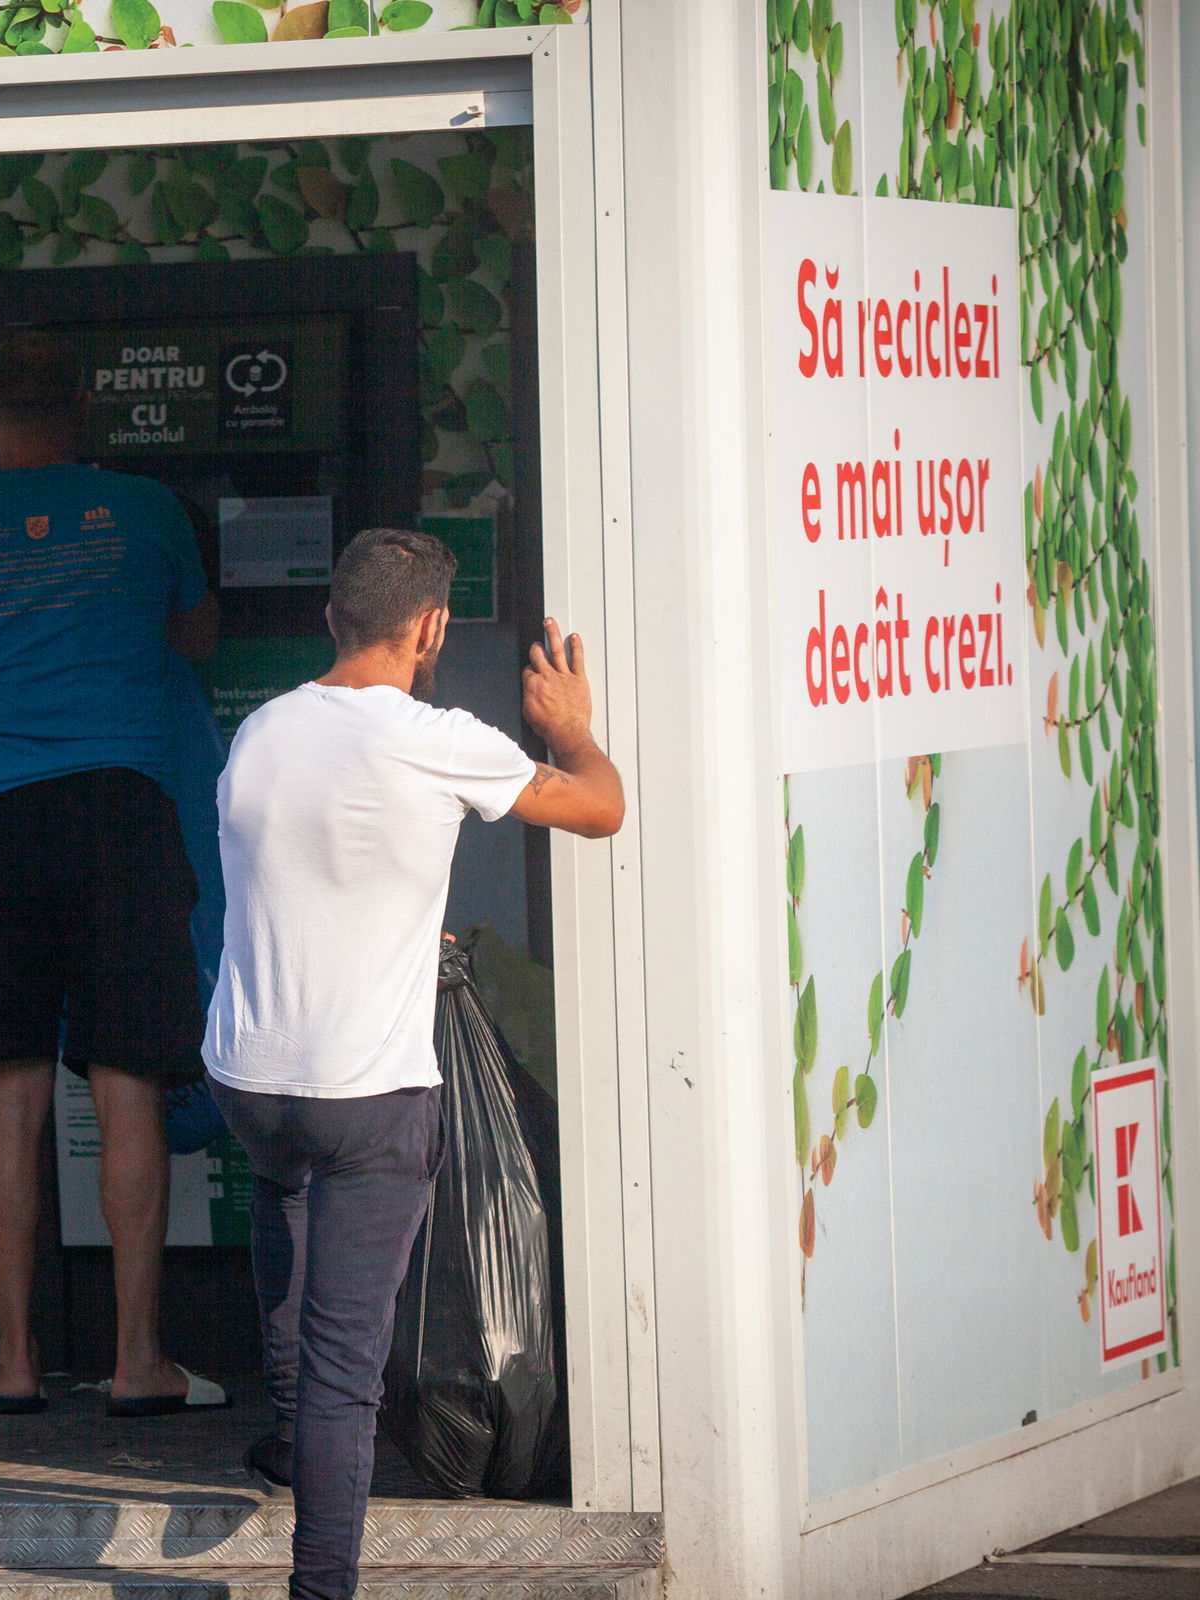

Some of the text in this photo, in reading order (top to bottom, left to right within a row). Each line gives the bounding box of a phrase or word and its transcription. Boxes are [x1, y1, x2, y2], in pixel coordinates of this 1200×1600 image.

[797, 258, 1000, 379] Să reciclezi
[121, 346, 180, 364] DOAR
[95, 366, 206, 391] PENTRU
[131, 404, 167, 427] CU
[233, 404, 278, 416] Ambalaj
[108, 425, 185, 445] simbolul
[801, 427, 990, 568] e mai ușor
[805, 581, 1013, 708] decât crezi.
[1107, 1255, 1157, 1309] Kaufland
